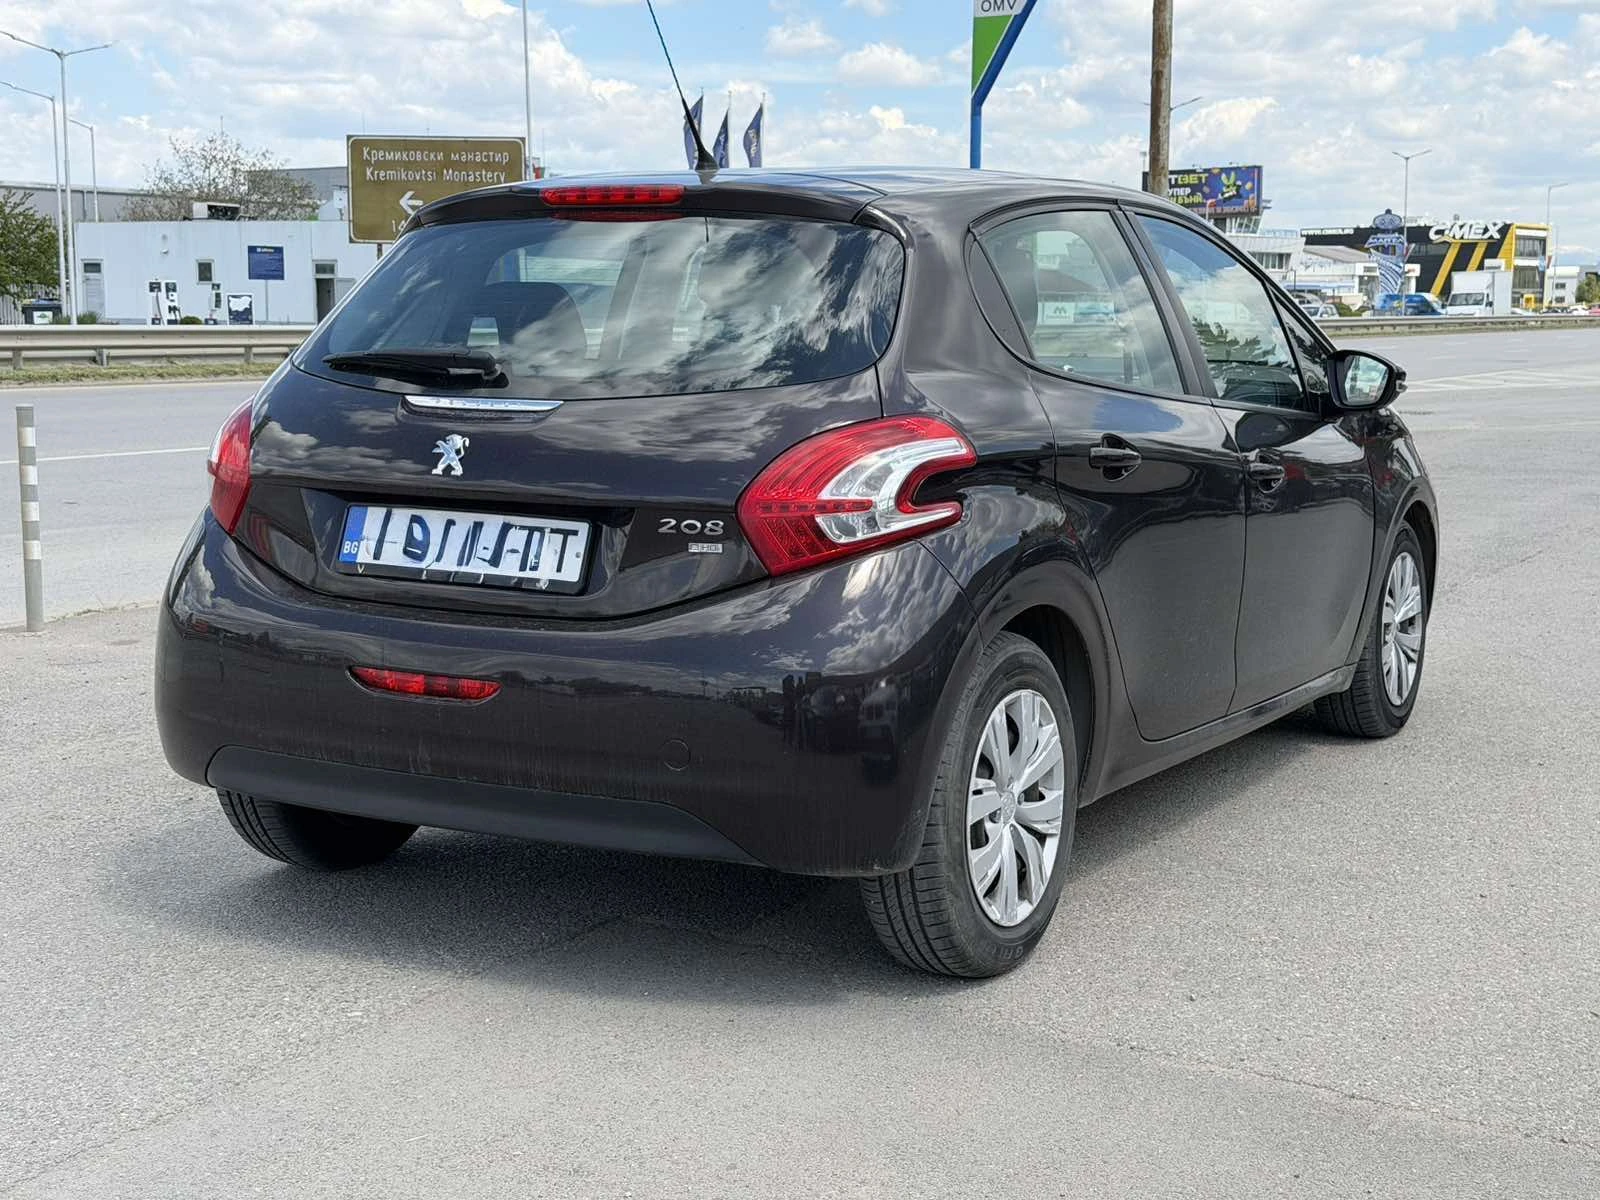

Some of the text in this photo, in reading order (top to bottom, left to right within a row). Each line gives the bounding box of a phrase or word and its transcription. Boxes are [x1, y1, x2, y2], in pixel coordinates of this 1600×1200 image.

[981, 0, 1016, 12] OMV
[363, 147, 510, 165] Кремиковски манастир
[366, 167, 506, 184] Kremikovtsi Monastery
[1429, 222, 1501, 241] CIMEX
[657, 518, 724, 535] 208
[343, 541, 358, 554] BG
